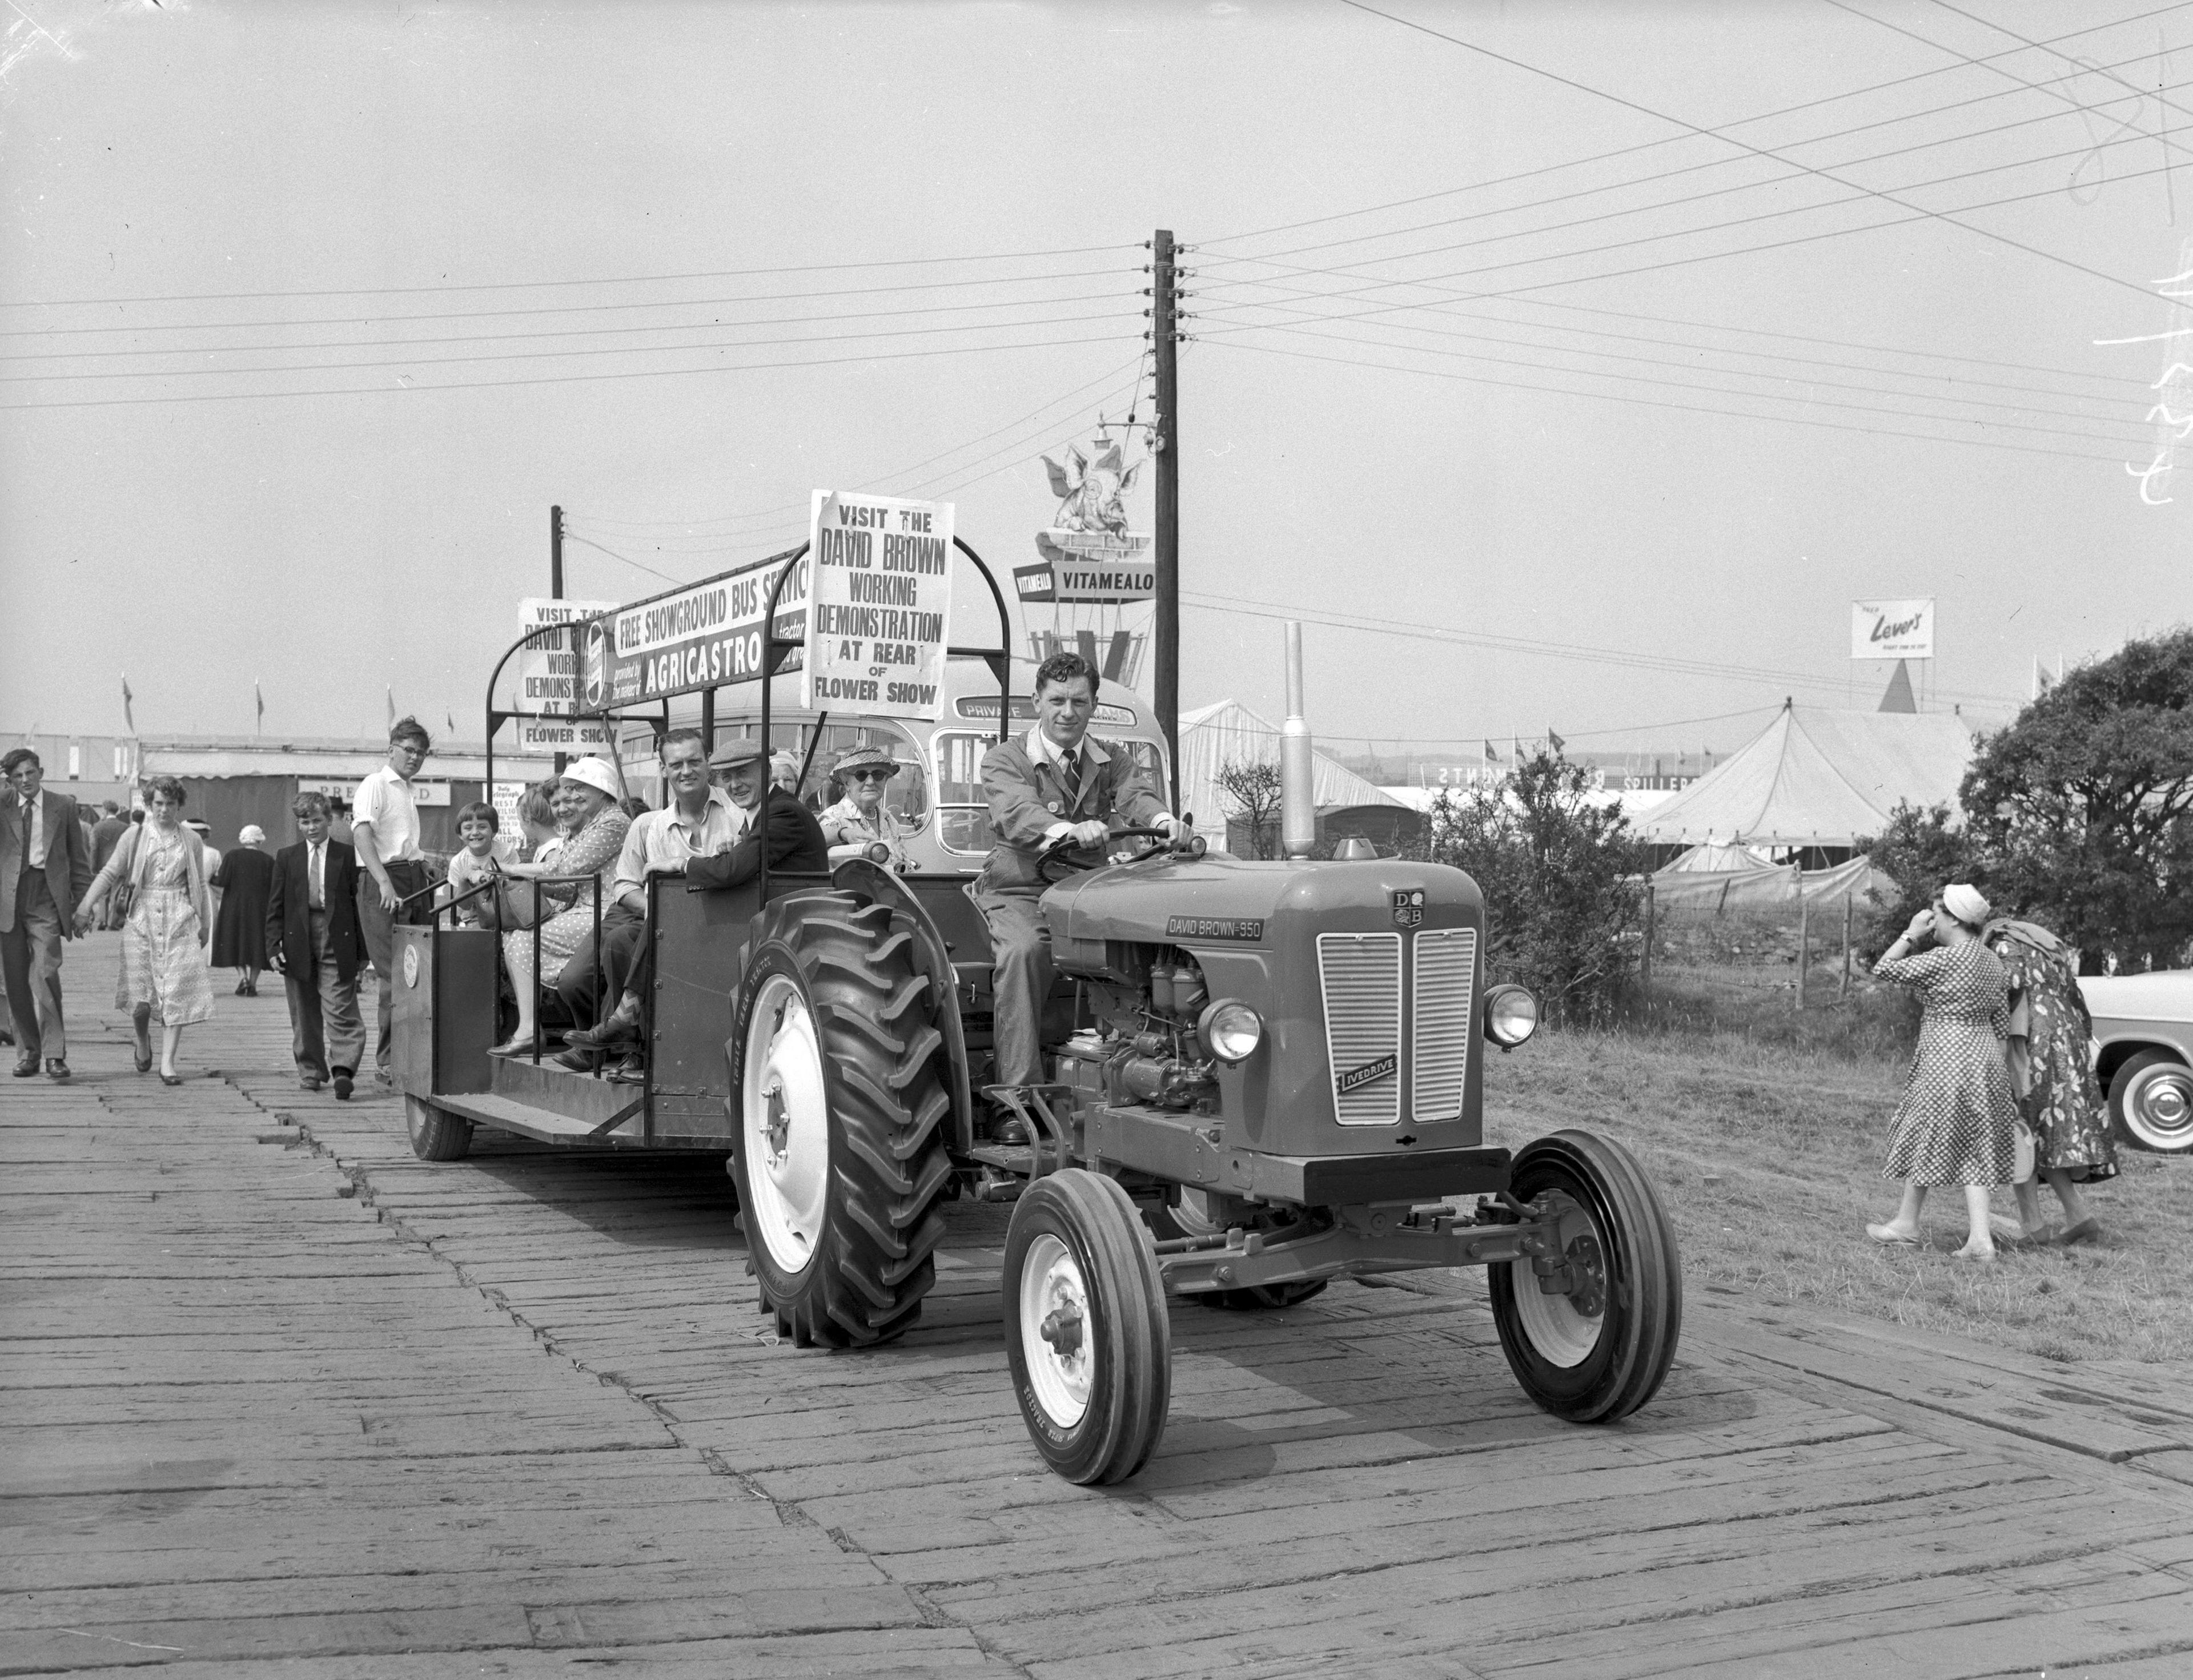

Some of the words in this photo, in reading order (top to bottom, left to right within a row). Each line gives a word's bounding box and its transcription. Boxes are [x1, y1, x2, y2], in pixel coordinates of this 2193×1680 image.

[839, 505, 887, 529] VISIT
[899, 510, 932, 533] THE
[820, 528, 873, 569] DAVID
[882, 533, 946, 576] BROWN
[849, 572, 917, 607] WORKING
[1017, 572, 1052, 594] VITAMEALO
[1063, 572, 1154, 590] VITAMEALO
[537, 608, 572, 622] VISIT
[620, 614, 641, 650] FREE
[645, 588, 726, 644] SHOWGROUND
[732, 577, 757, 620] BUS
[762, 560, 809, 611] SERVIC
[779, 618, 805, 639] tractor
[817, 604, 942, 643] DEMONSTRATION
[525, 624, 563, 650] DAVID
[838, 640, 862, 661] AT
[873, 642, 915, 665] REAR
[869, 666, 887, 677] OF
[815, 676, 878, 701] FLOWER
[886, 682, 937, 705] SHOW
[544, 701, 560, 714] AT
[965, 705, 1022, 718] PRIVAE
[526, 728, 575, 743] FLOWER
[1396, 893, 1408, 906] D
[1170, 919, 1196, 934] DAVID
[1411, 909, 1422, 922] B
[1342, 1058, 1395, 1092] LIVEDRIVE
[1023, 1384, 1046, 1429] TRACTOR
